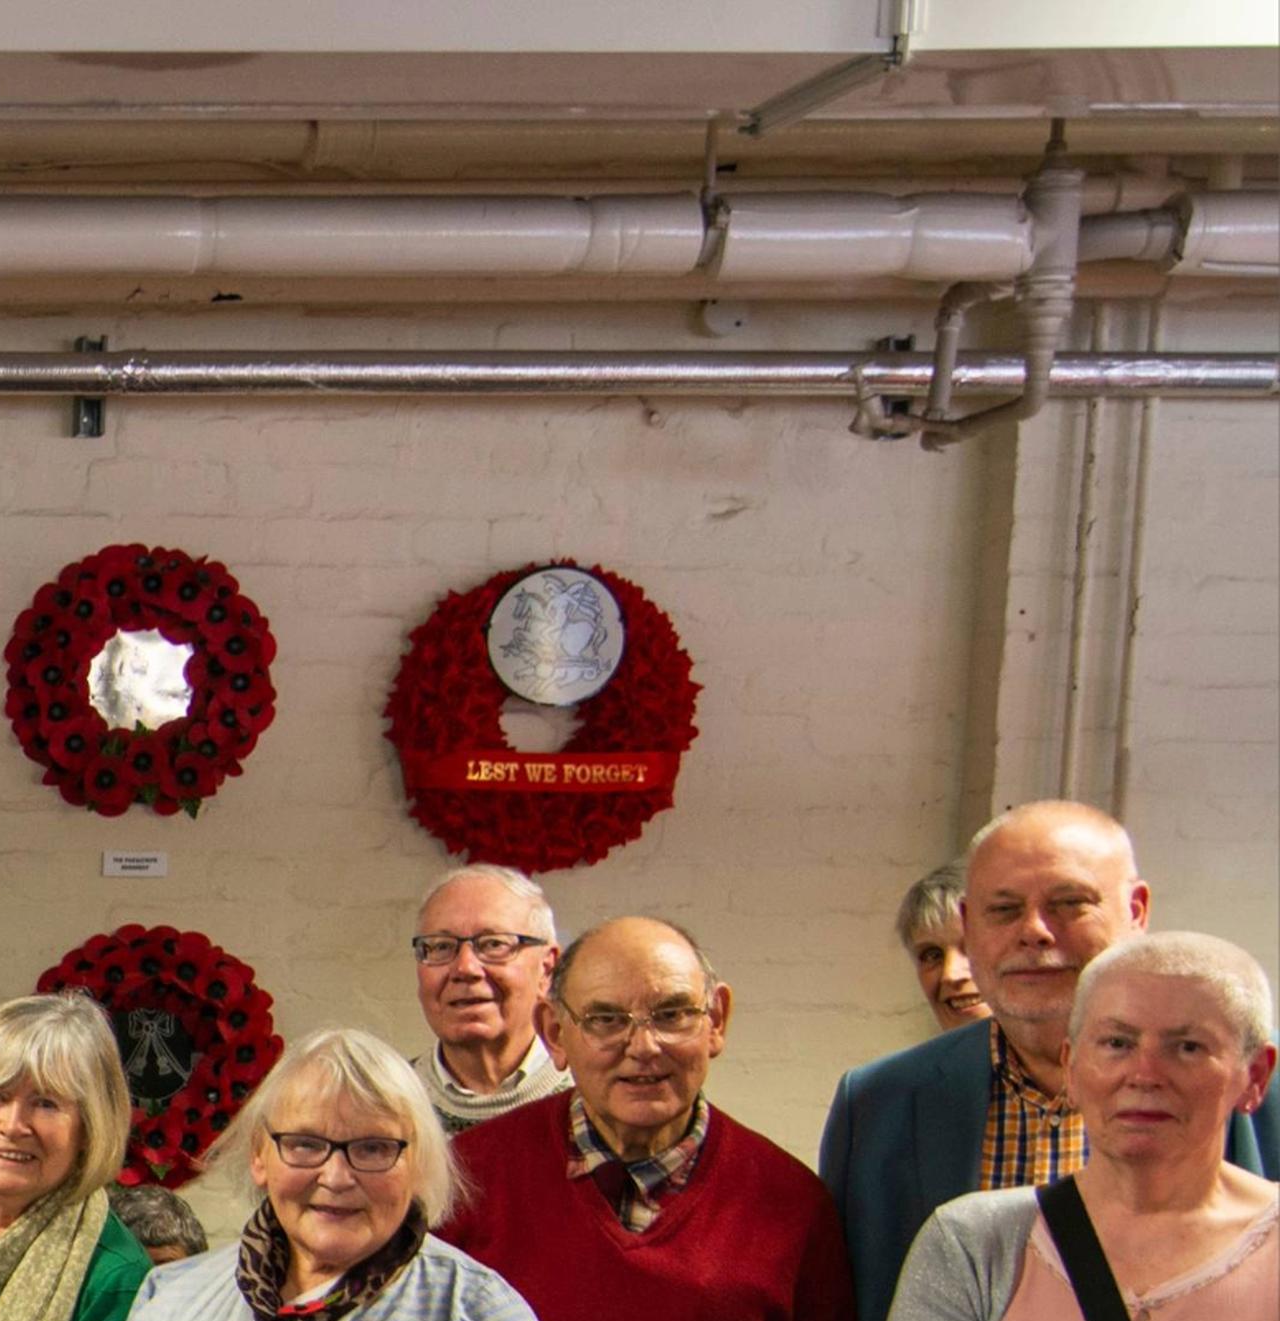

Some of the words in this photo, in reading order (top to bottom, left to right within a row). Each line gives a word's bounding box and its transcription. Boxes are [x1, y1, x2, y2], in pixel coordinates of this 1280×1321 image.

[466, 761, 519, 782] LEST
[525, 763, 557, 783] WE
[562, 763, 649, 783] FORGET
